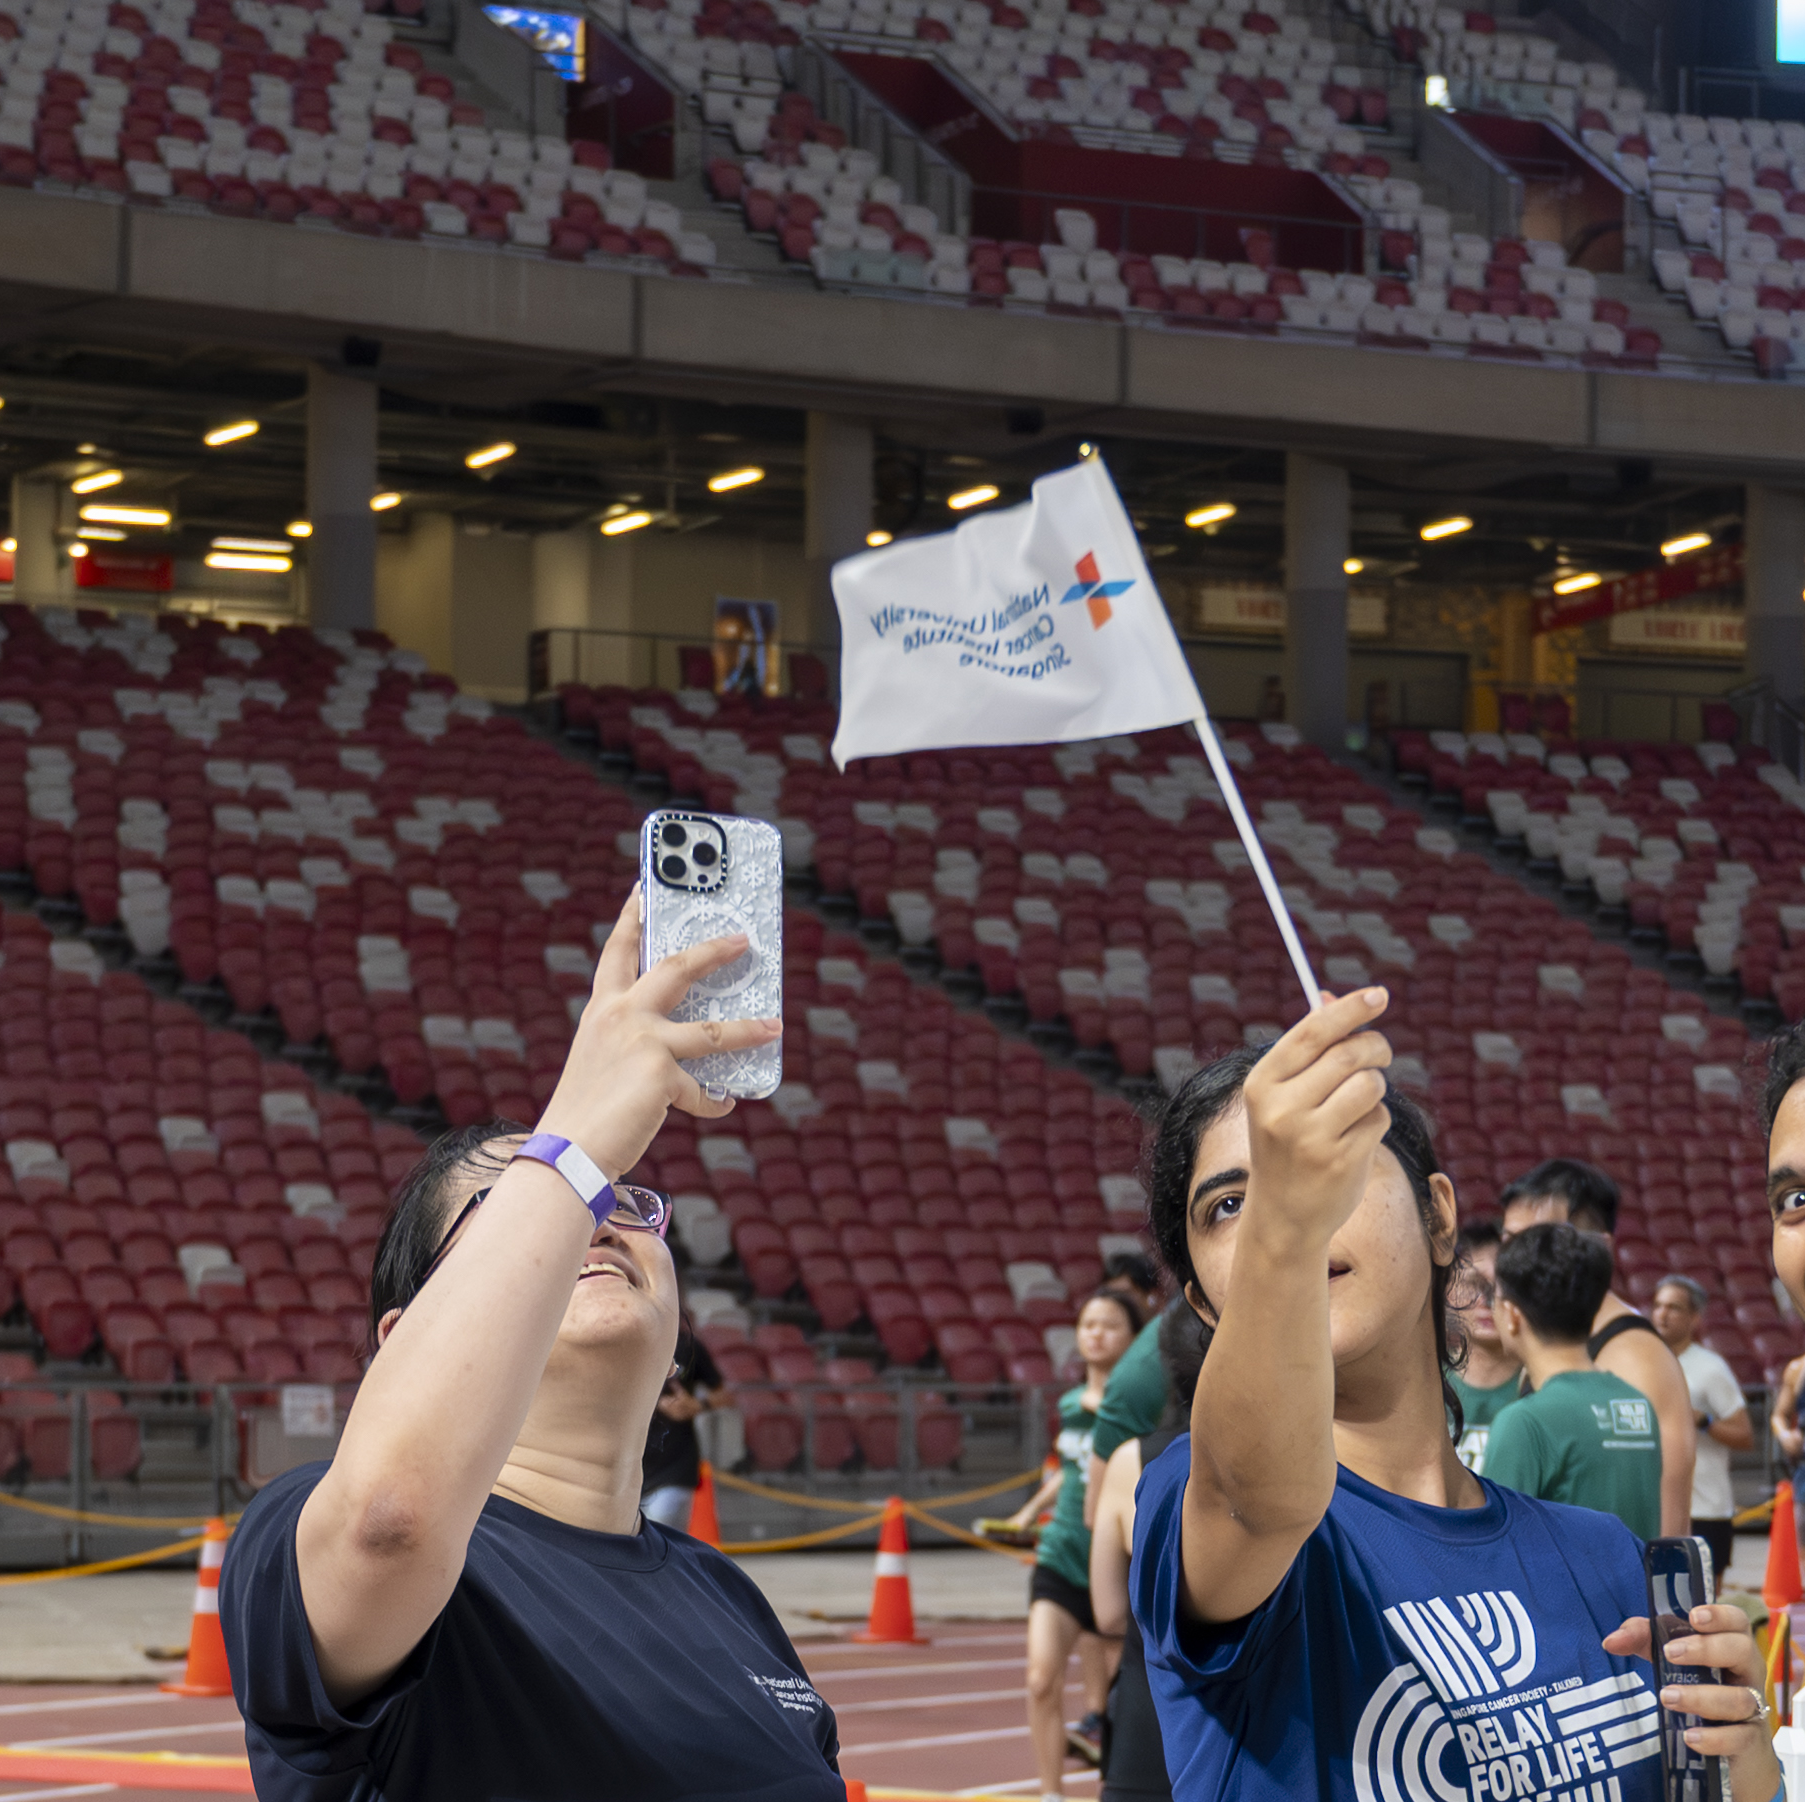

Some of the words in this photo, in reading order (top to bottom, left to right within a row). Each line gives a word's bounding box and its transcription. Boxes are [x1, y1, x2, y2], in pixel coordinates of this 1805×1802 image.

[1451, 1703, 1489, 1720] INGAPRE
[1488, 1693, 1520, 1714] CANCER
[1457, 1703, 1553, 1765] RELAY
[1535, 1731, 1607, 1788] LIFE
